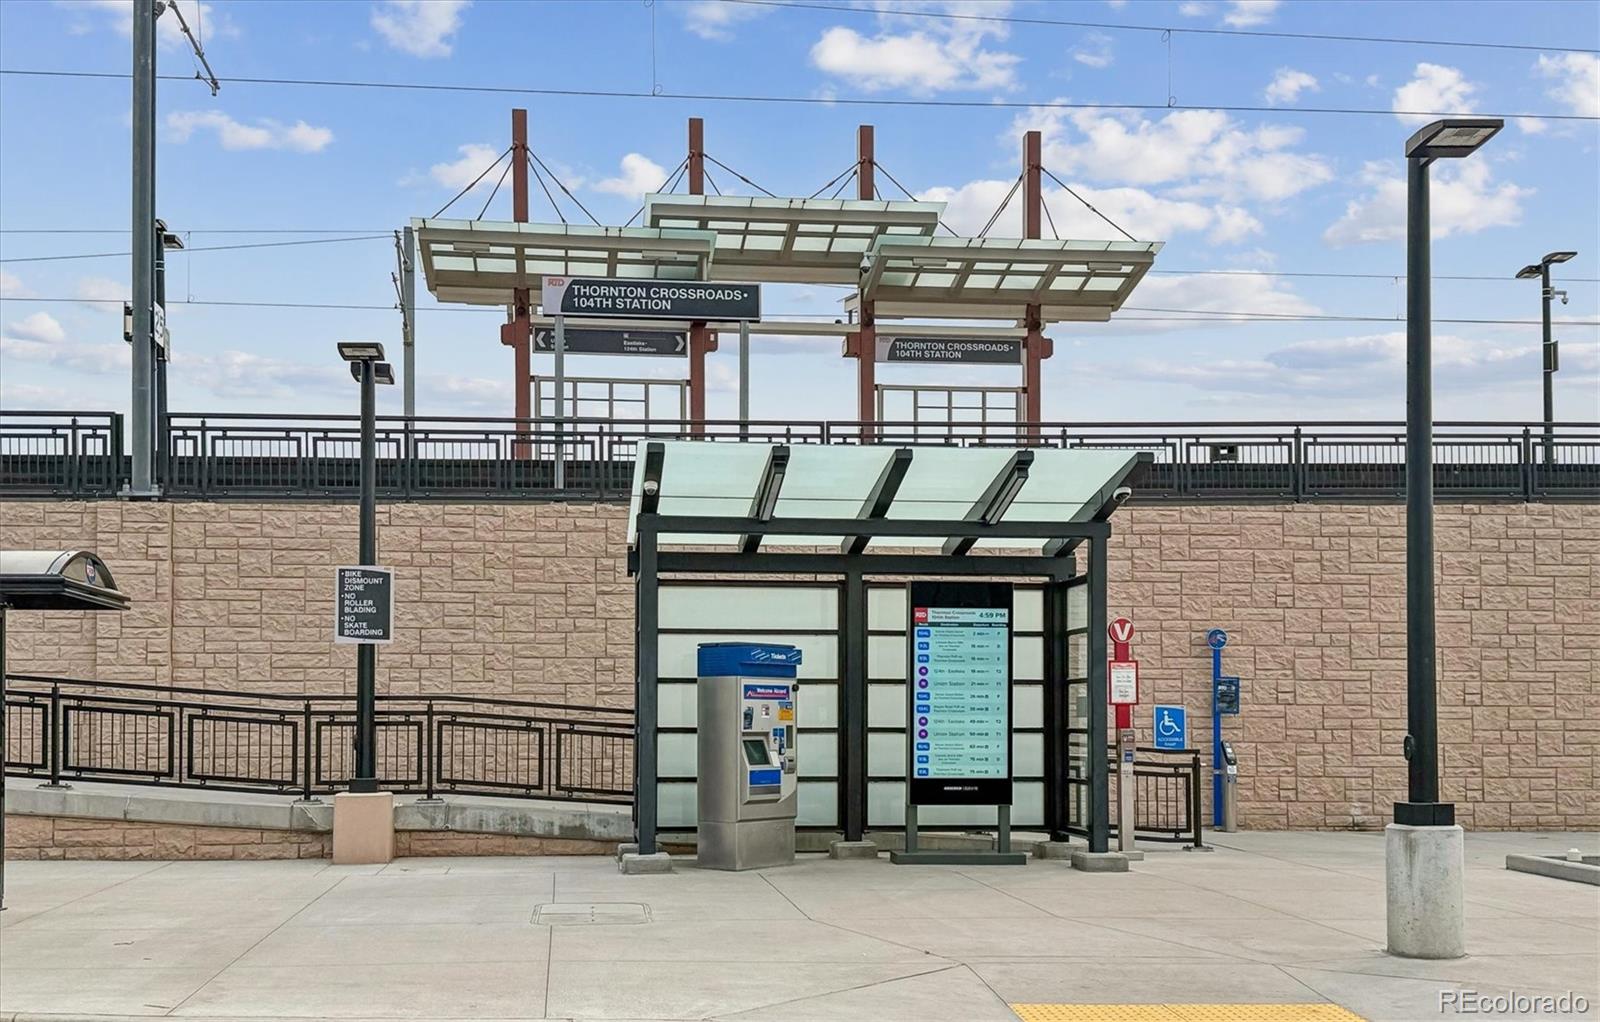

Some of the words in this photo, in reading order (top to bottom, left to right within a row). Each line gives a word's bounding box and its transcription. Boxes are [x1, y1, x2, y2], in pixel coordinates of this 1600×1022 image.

[572, 285, 647, 298] THORNTON
[573, 297, 612, 309] 104TH
[616, 299, 671, 310] STATION
[895, 341, 945, 351] THORNTON
[896, 349, 922, 358] 104TH
[924, 350, 962, 359] STATION
[1113, 622, 1131, 641] V
